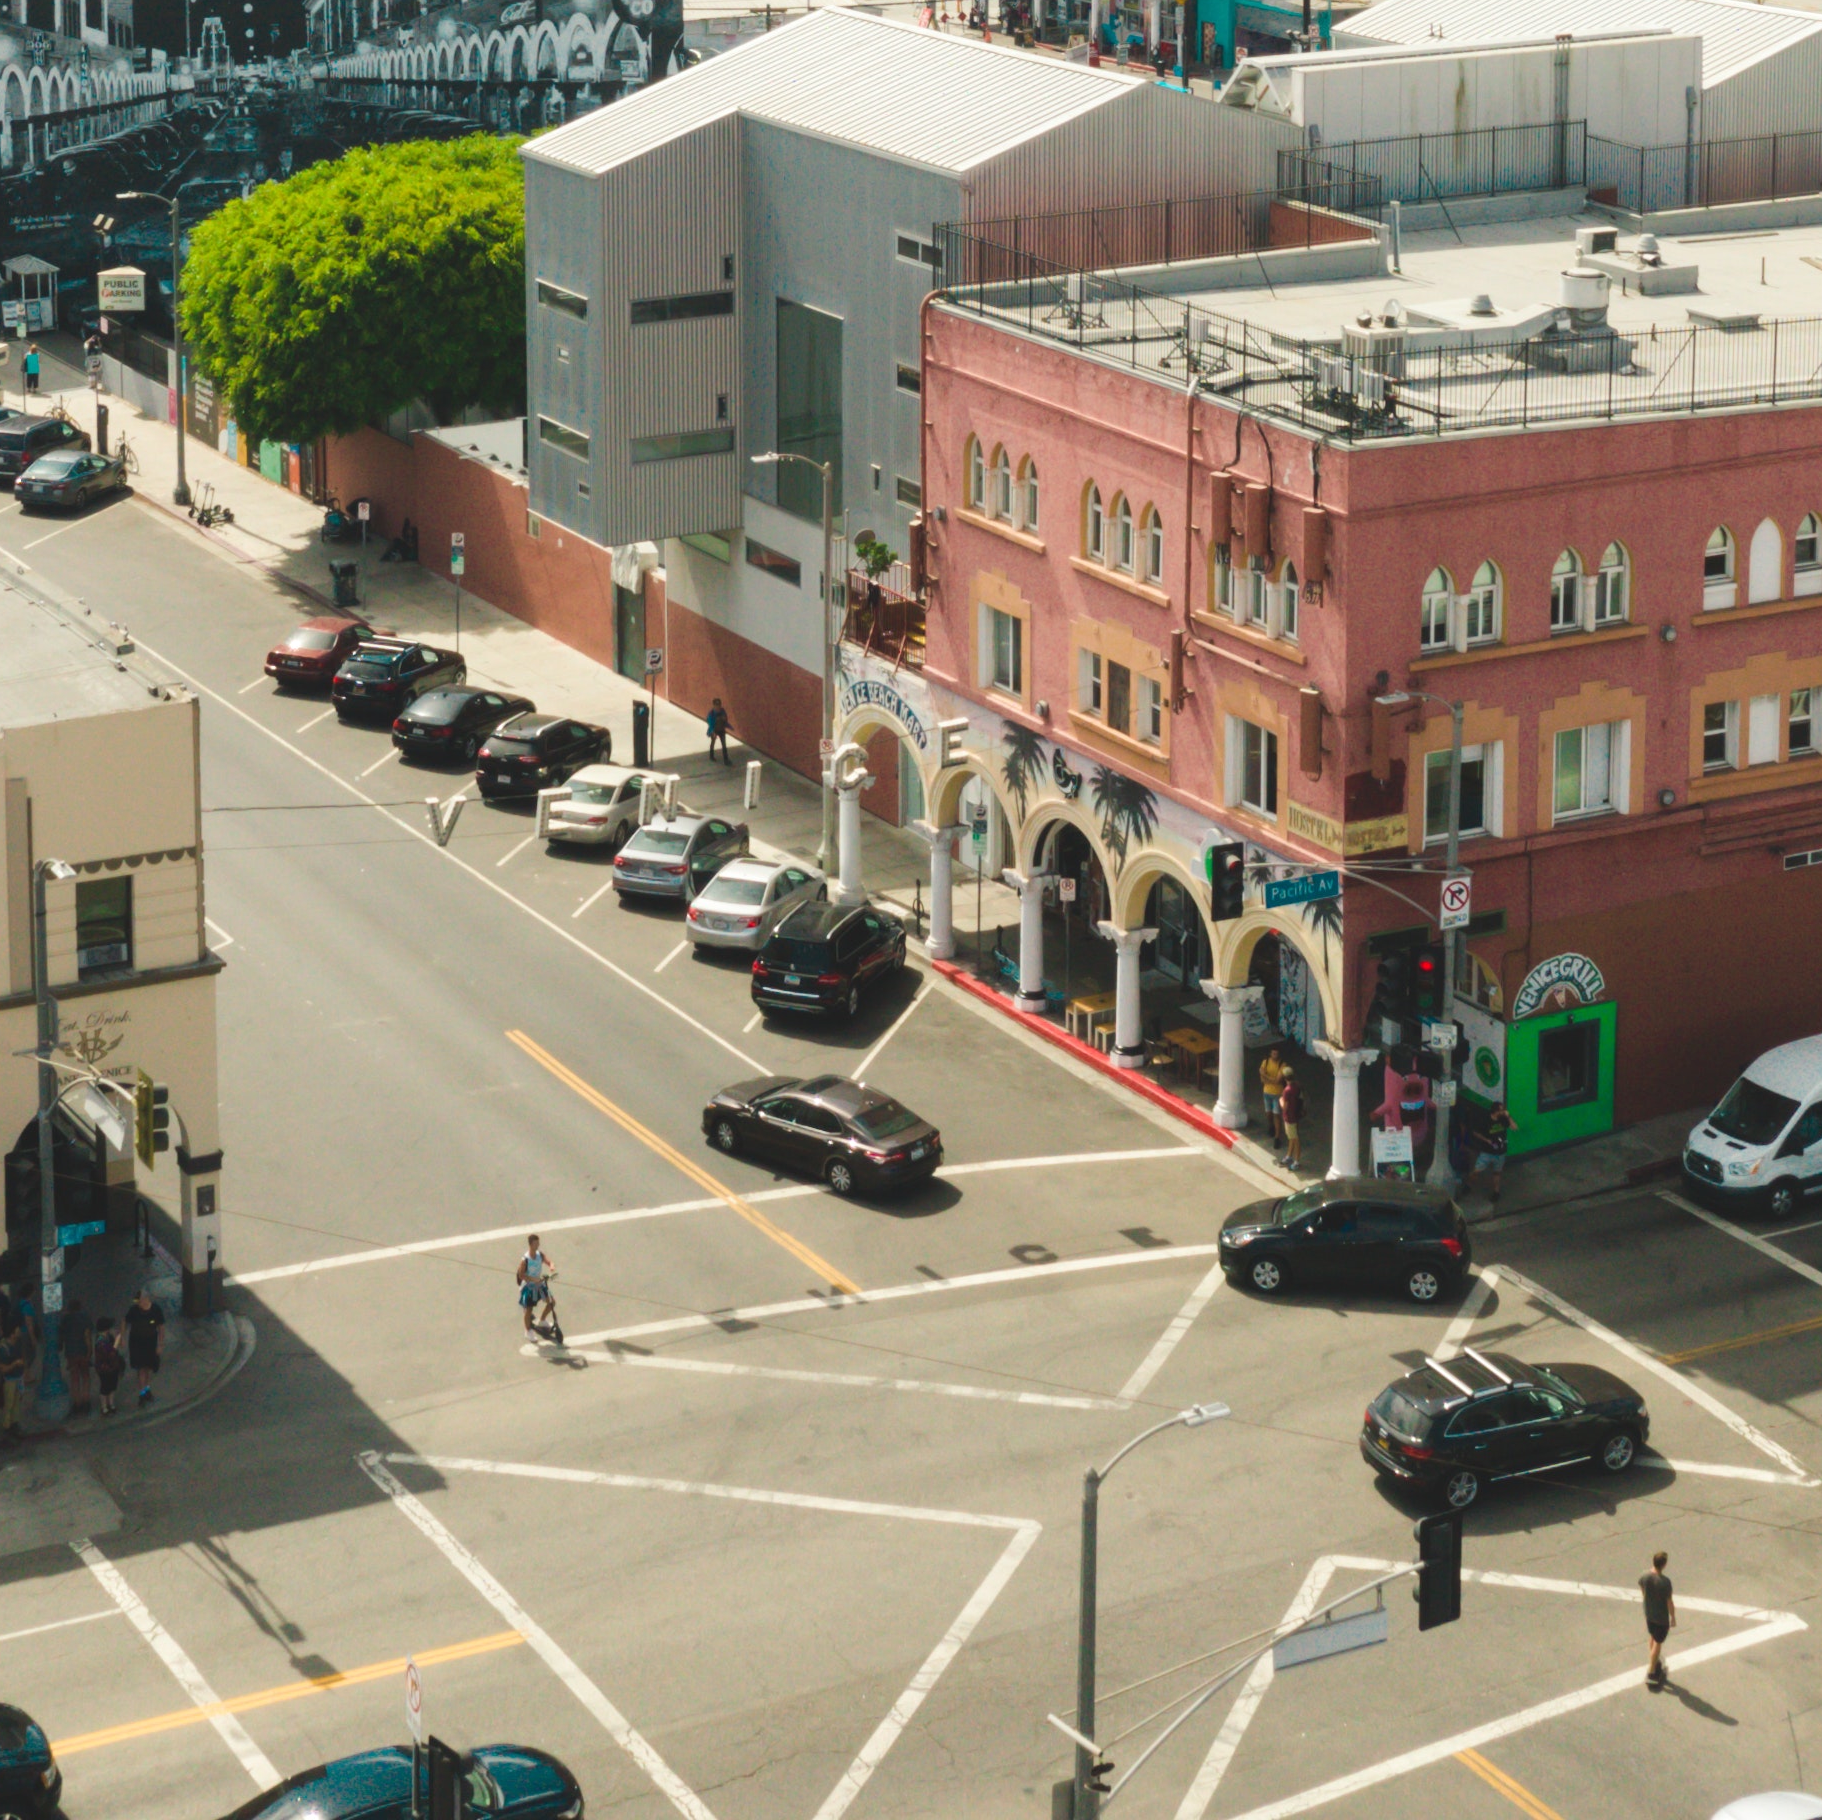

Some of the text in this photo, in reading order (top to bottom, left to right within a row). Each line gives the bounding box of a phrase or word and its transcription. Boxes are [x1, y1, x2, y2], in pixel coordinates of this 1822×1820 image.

[630, 0, 654, 17] CO
[104, 280, 139, 288] PUBLIC
[841, 683, 869, 715] VENCE
[868, 682, 898, 714] BEACH
[1271, 877, 1334, 901] Pacific Av
